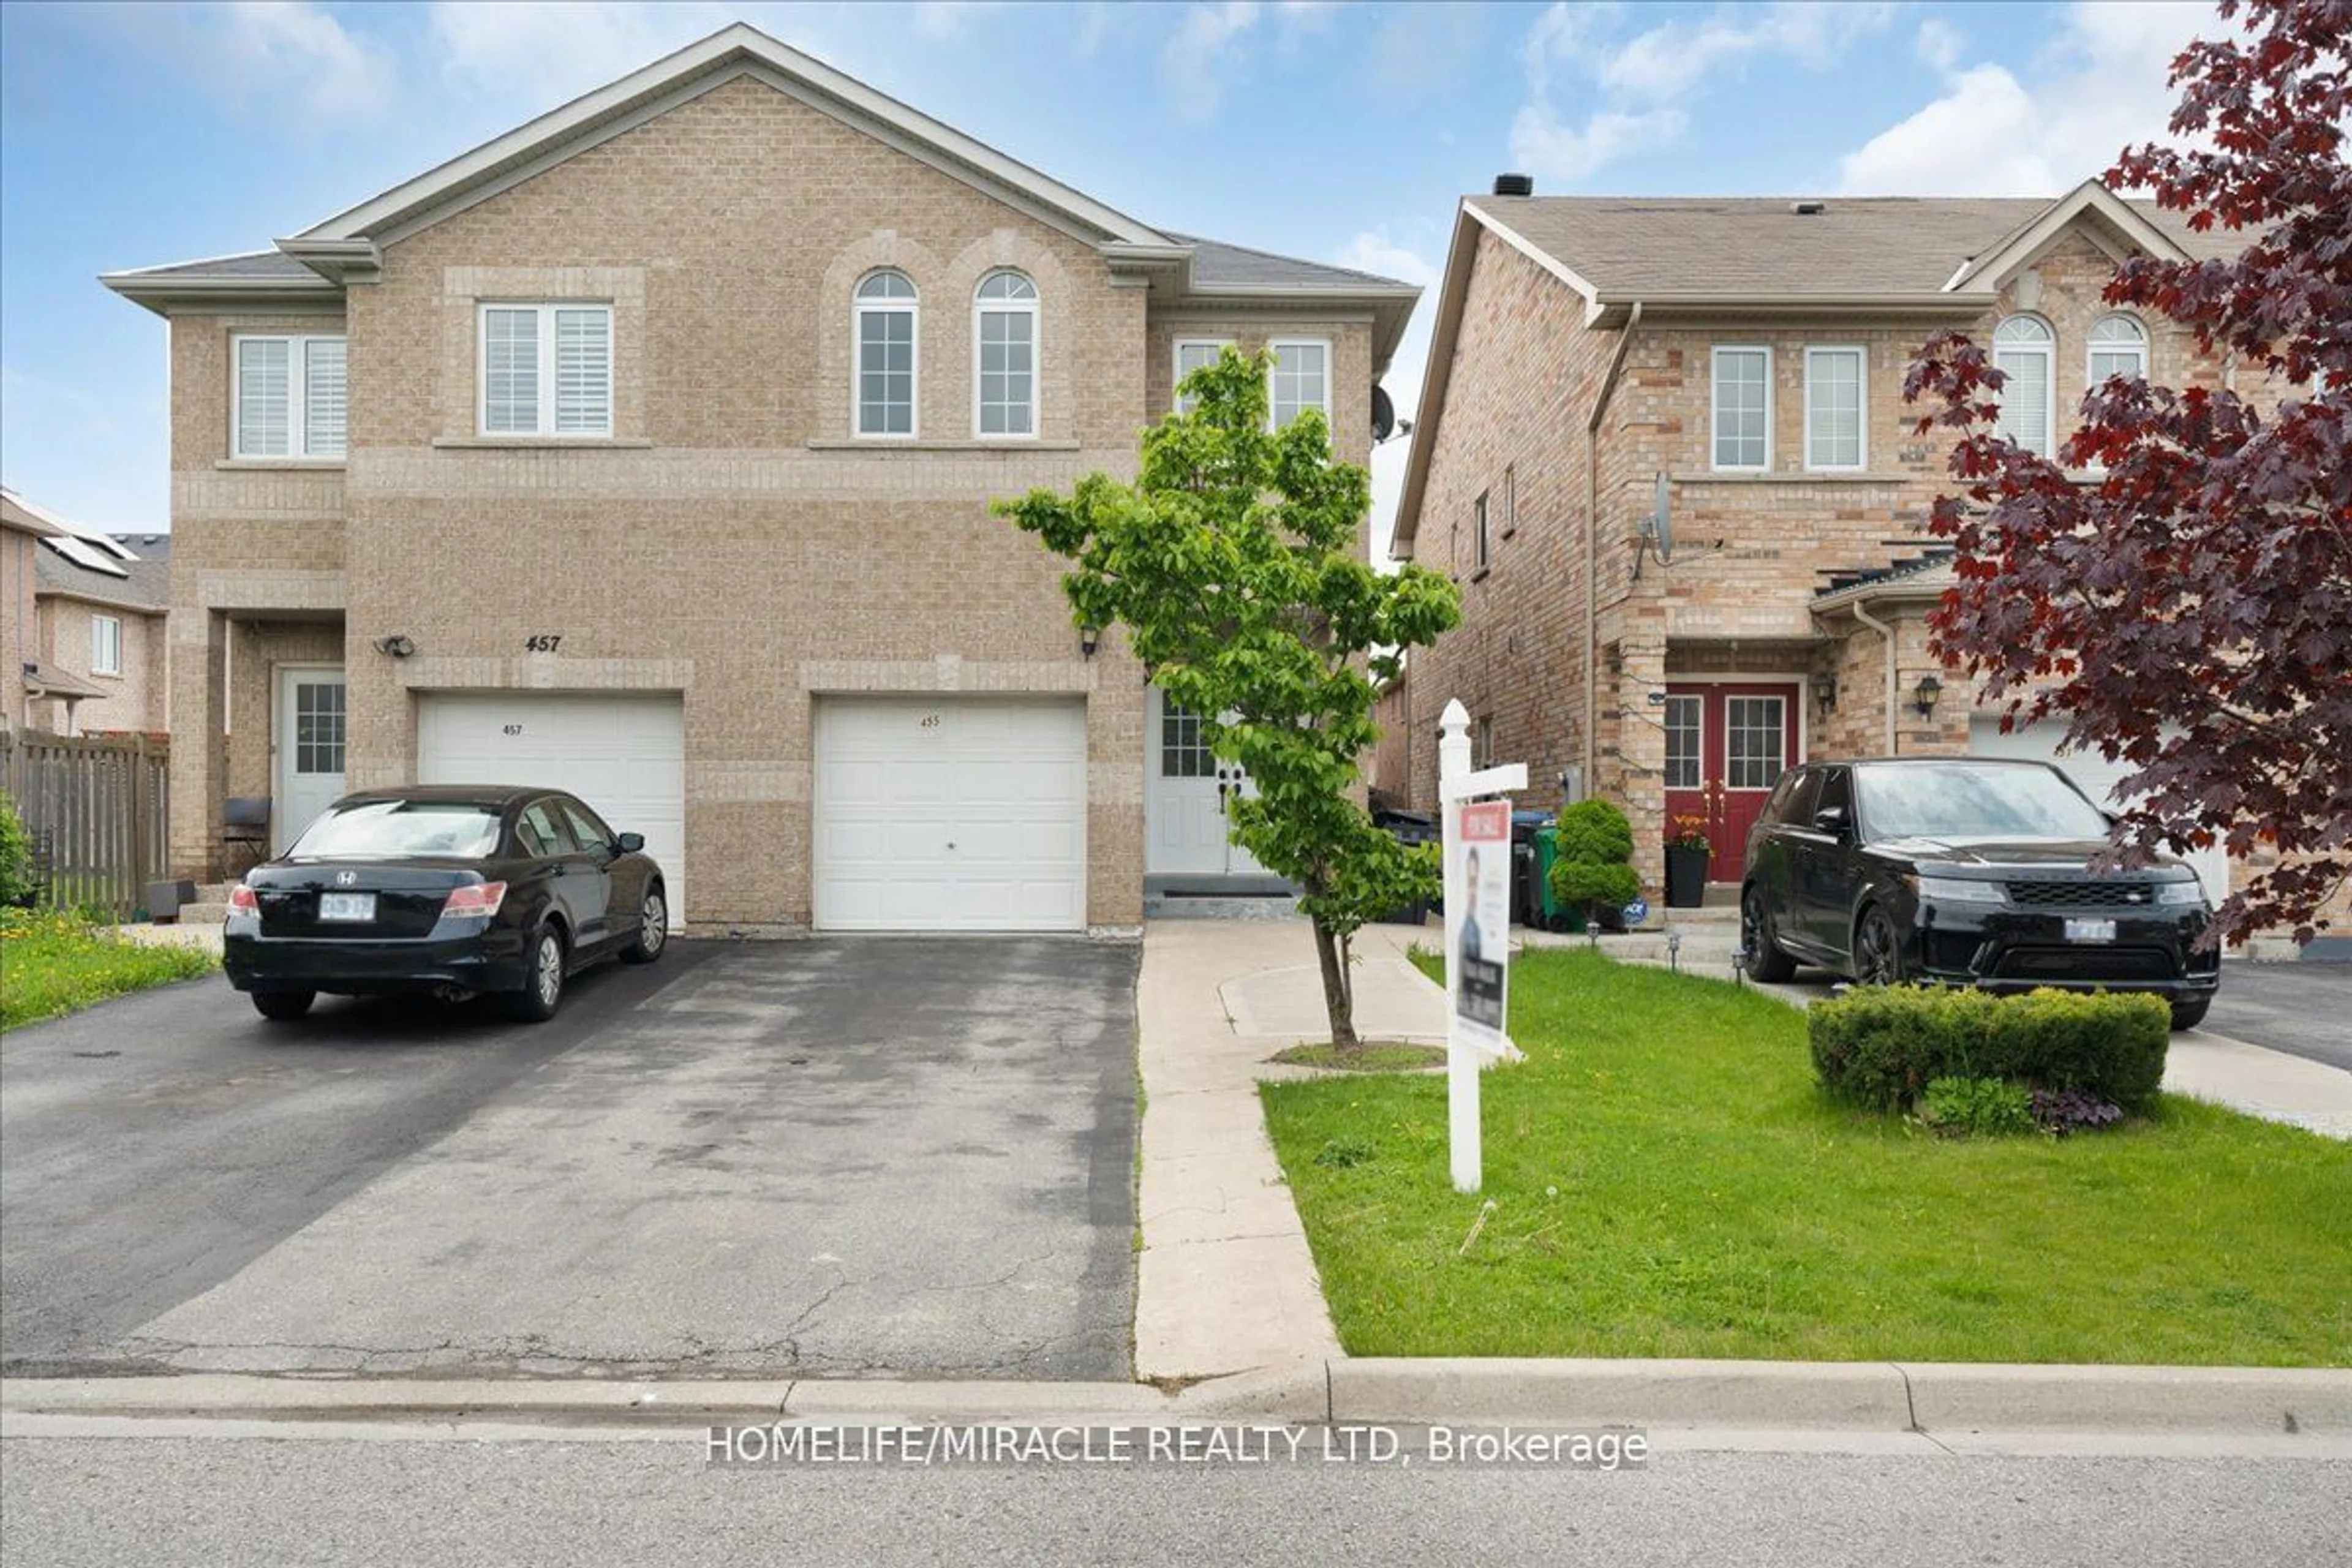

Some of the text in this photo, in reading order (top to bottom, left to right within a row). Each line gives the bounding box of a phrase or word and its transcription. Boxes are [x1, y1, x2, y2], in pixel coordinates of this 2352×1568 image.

[525, 635, 561, 652] 457
[921, 715, 940, 728] 455
[503, 725, 522, 736] 457
